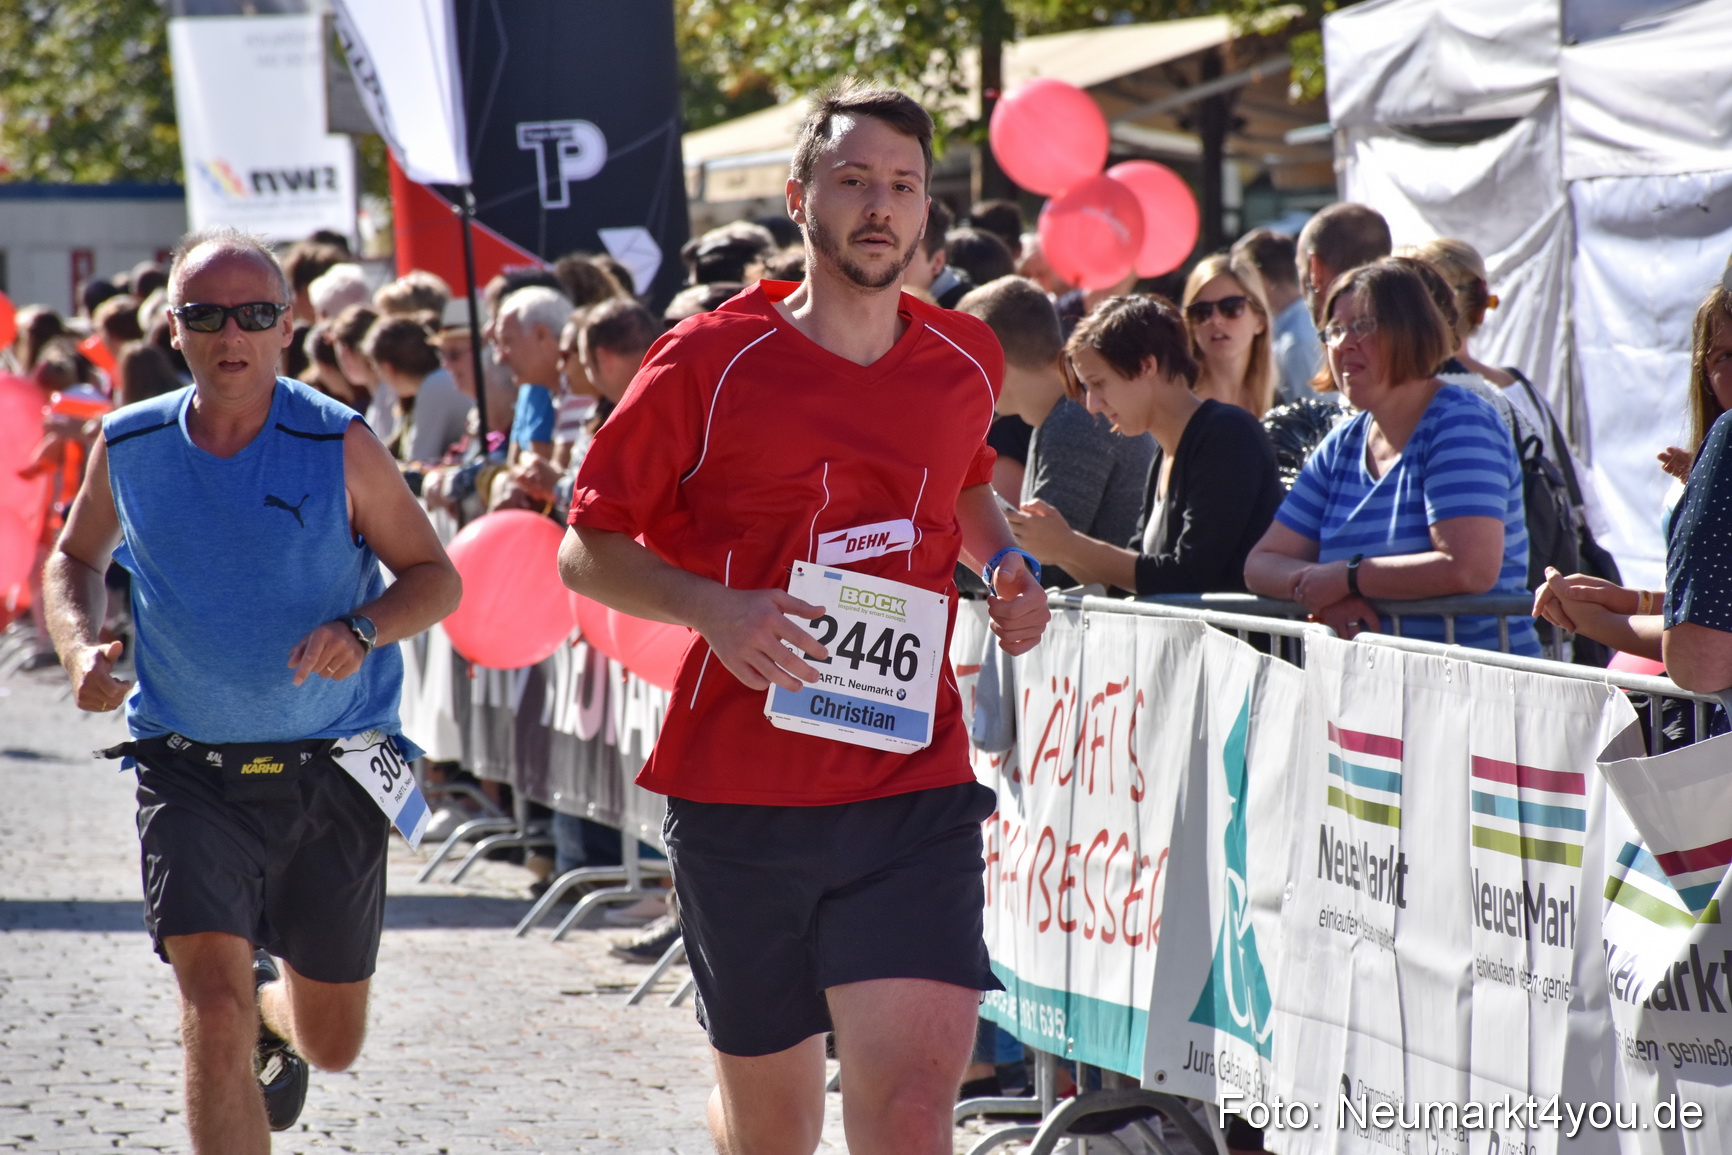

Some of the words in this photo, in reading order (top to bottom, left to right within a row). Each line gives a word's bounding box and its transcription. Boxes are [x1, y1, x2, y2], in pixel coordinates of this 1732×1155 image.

[845, 531, 890, 553] DEHN
[837, 603, 860, 613] inspired
[869, 610, 885, 618] smart
[885, 614, 907, 623] concepts
[839, 585, 907, 617] BOCK
[802, 614, 921, 682] 2446
[816, 672, 847, 687] ARTL
[848, 678, 894, 698] Neumarkt
[809, 694, 896, 732] Christian
[240, 763, 284, 775] KARHU
